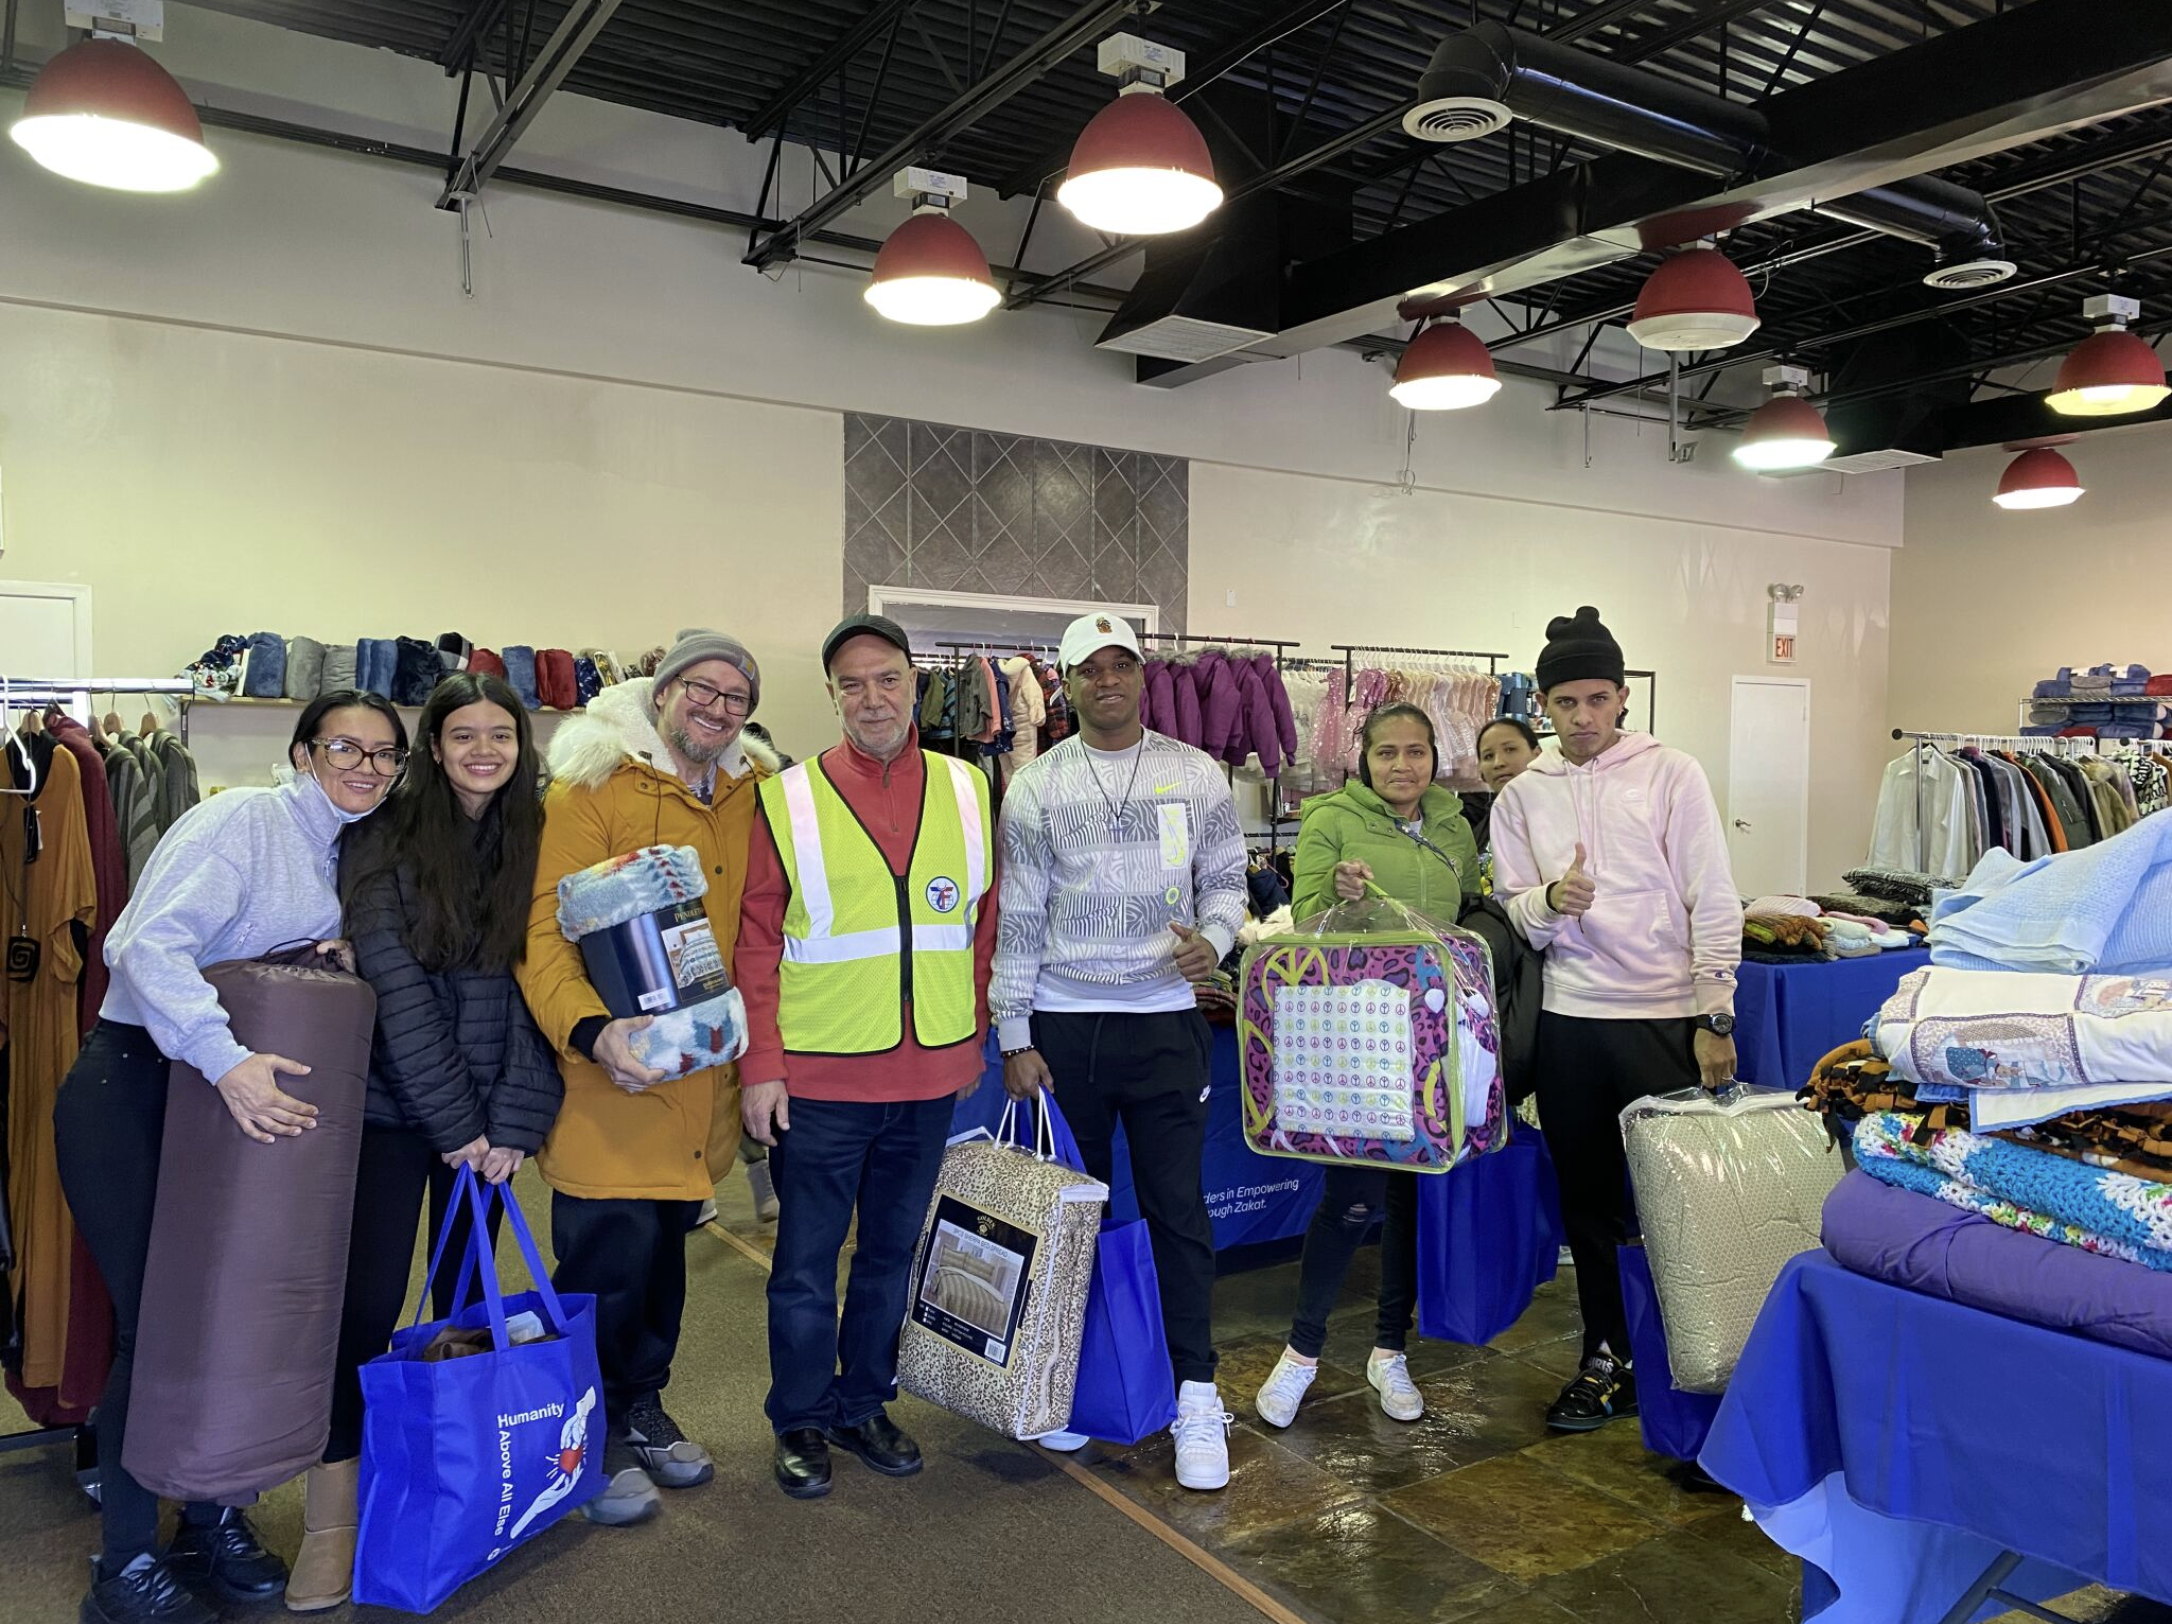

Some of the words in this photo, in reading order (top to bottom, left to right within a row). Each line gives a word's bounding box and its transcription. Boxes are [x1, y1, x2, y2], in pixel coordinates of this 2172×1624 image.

[1776, 637, 1794, 658] EXIT
[1226, 1188, 1234, 1199] in
[1237, 1178, 1299, 1198] Empowering
[1208, 1204, 1233, 1218] ough
[1234, 1199, 1267, 1213] Zakat.
[497, 1402, 565, 1429] Humanity
[500, 1430, 512, 1479] Above
[502, 1482, 514, 1503] All
[494, 1504, 511, 1537] Else
